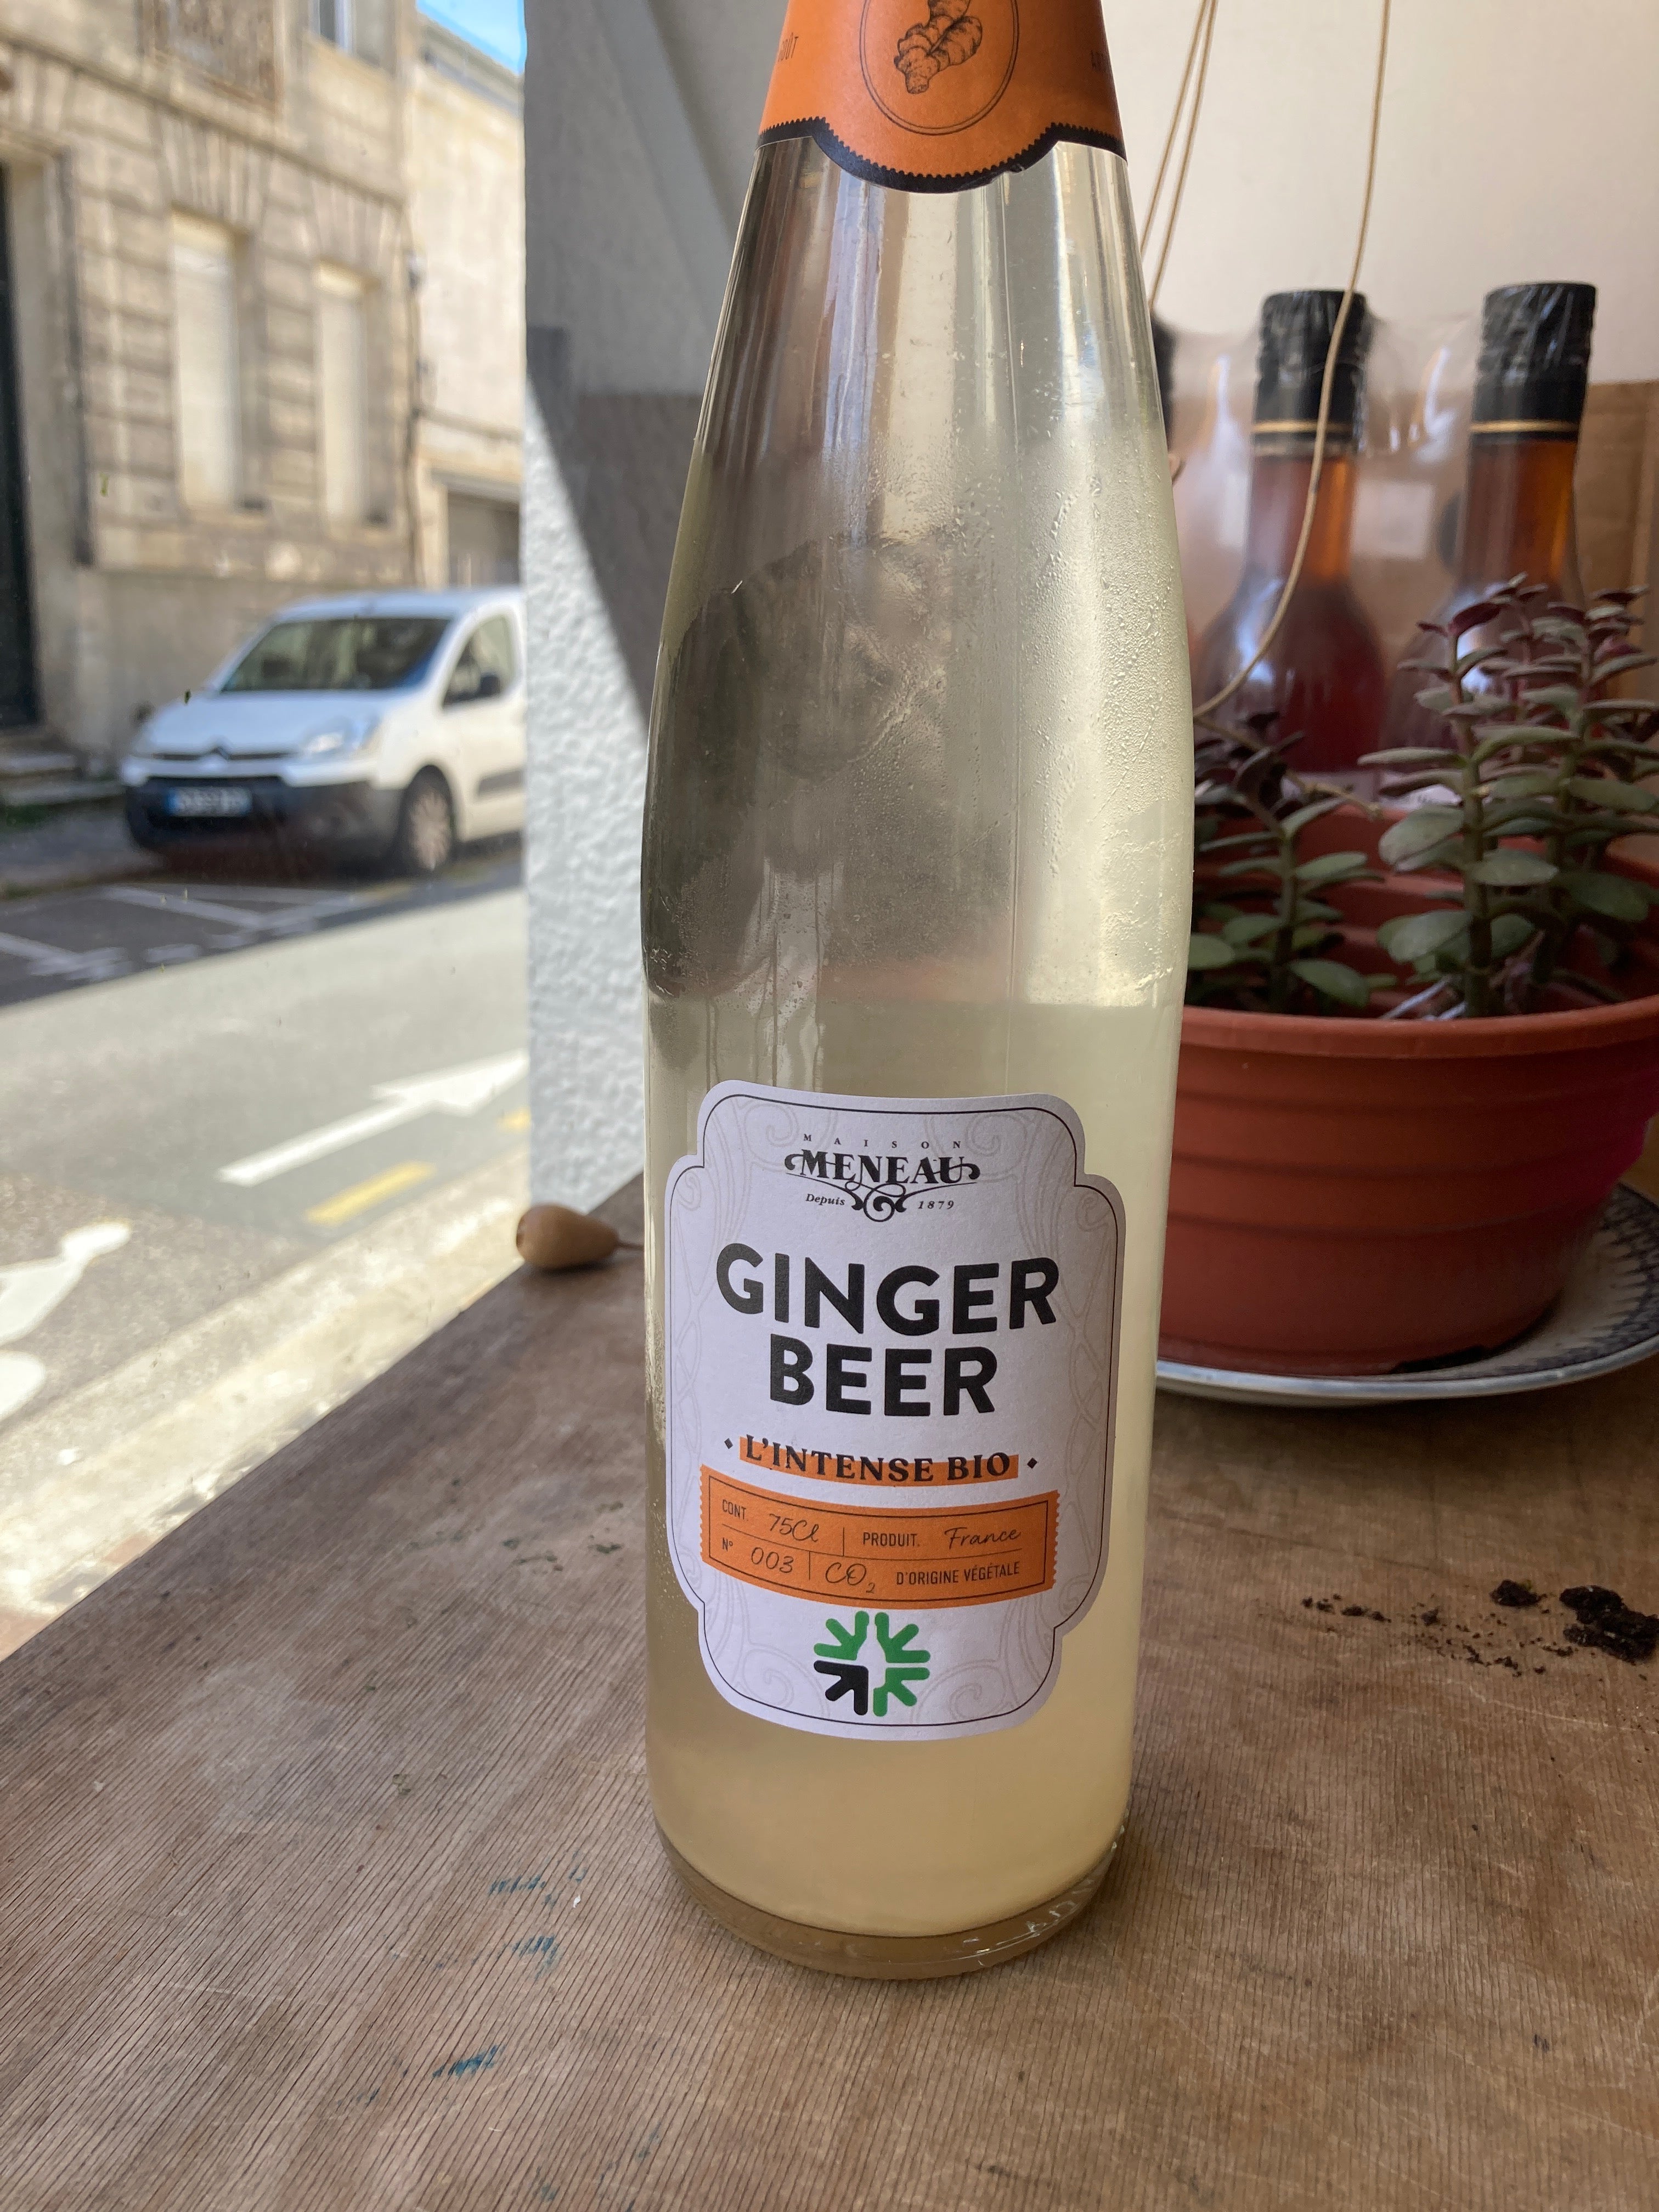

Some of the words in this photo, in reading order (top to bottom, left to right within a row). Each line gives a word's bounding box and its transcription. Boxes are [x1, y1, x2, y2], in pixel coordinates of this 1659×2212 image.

[803, 1133, 962, 1149] MAISON
[784, 1149, 981, 1185] MENEAU
[805, 1193, 846, 1206] Depuis
[918, 1200, 955, 1210] 1879
[716, 1243, 1060, 1336] GINGER
[770, 1333, 998, 1417] BEER
[746, 1434, 934, 1482] L'INTENSE
[947, 1452, 1010, 1481] BIO
[721, 1499, 749, 1522] CONT.
[862, 1531, 921, 1548] PRODUIT.
[944, 1526, 1023, 1550] France
[751, 1547, 794, 1574] 003
[896, 1570, 959, 1585] D'ORIGINE
[963, 1561, 1020, 1582] VÉGÉTALE
